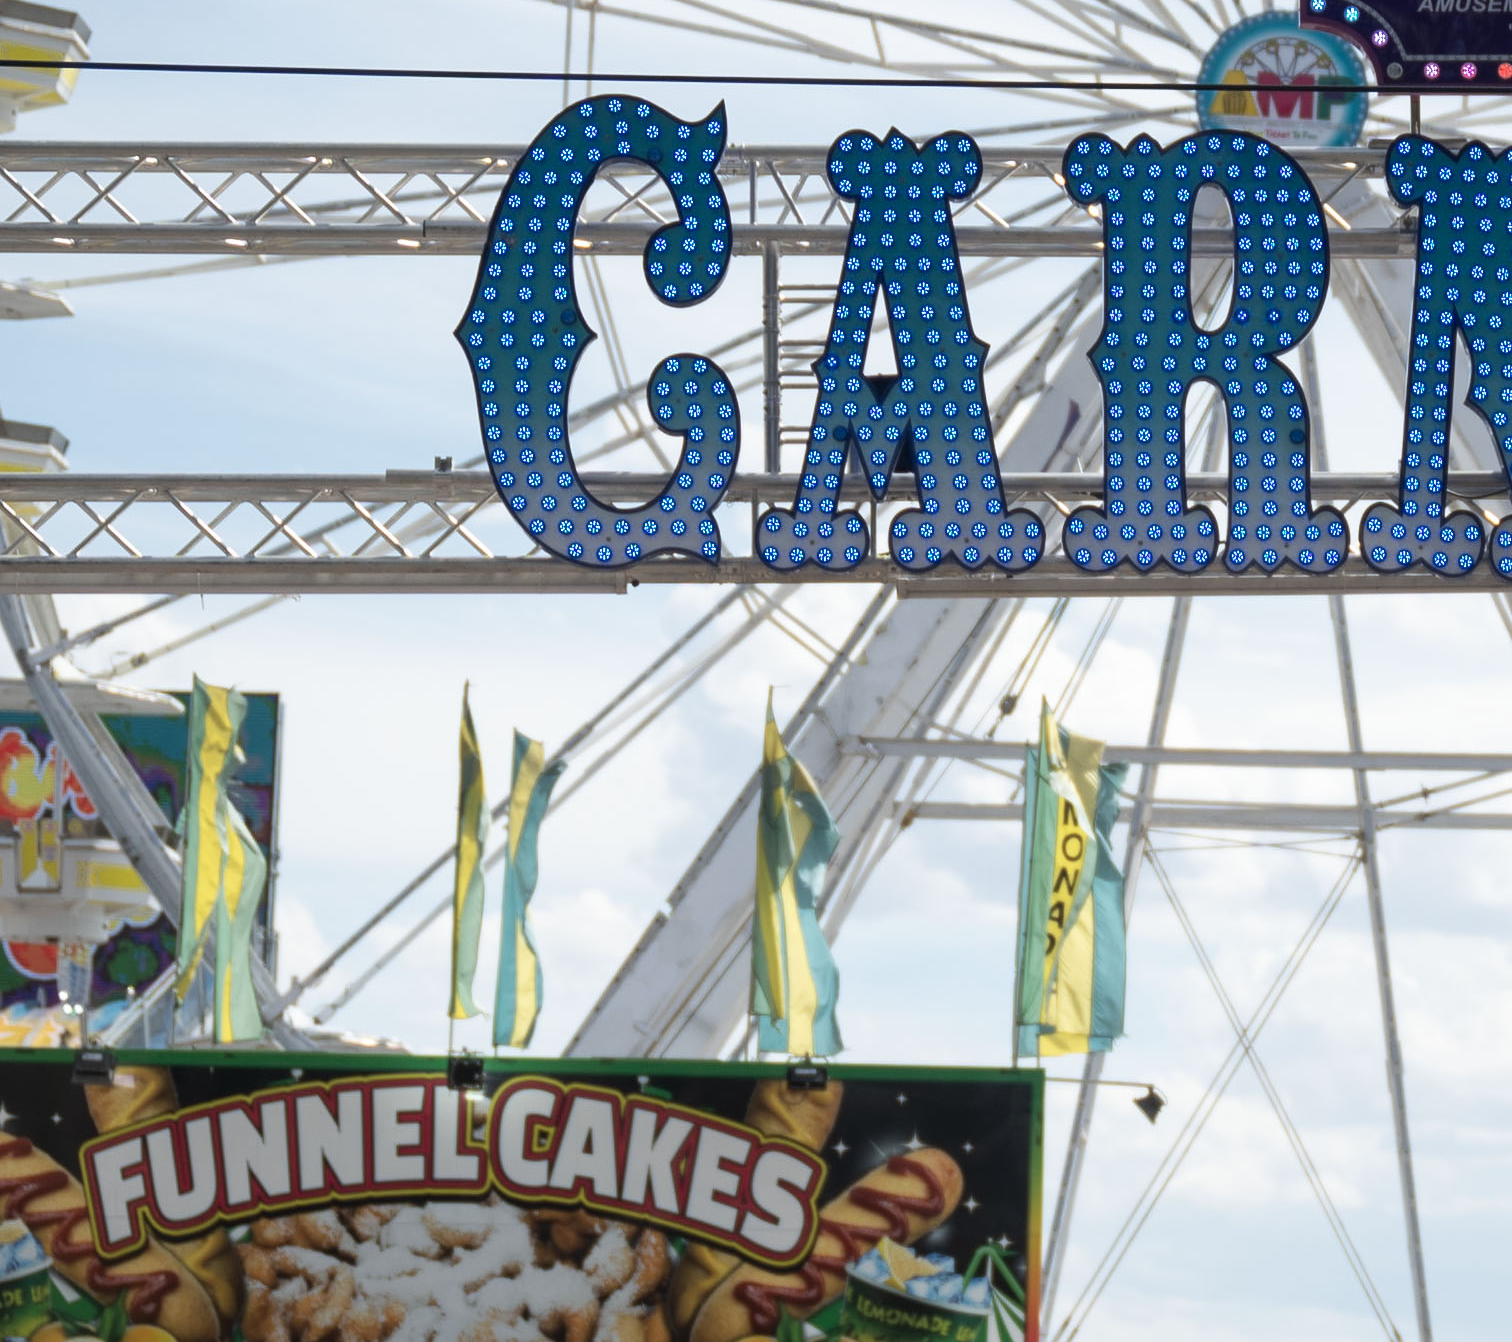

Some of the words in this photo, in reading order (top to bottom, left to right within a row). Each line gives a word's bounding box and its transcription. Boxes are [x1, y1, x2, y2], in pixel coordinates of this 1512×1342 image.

[1210, 68, 1358, 121] AMP
[90, 1082, 481, 1247] FUNNEL
[497, 1084, 816, 1256] CAKES
